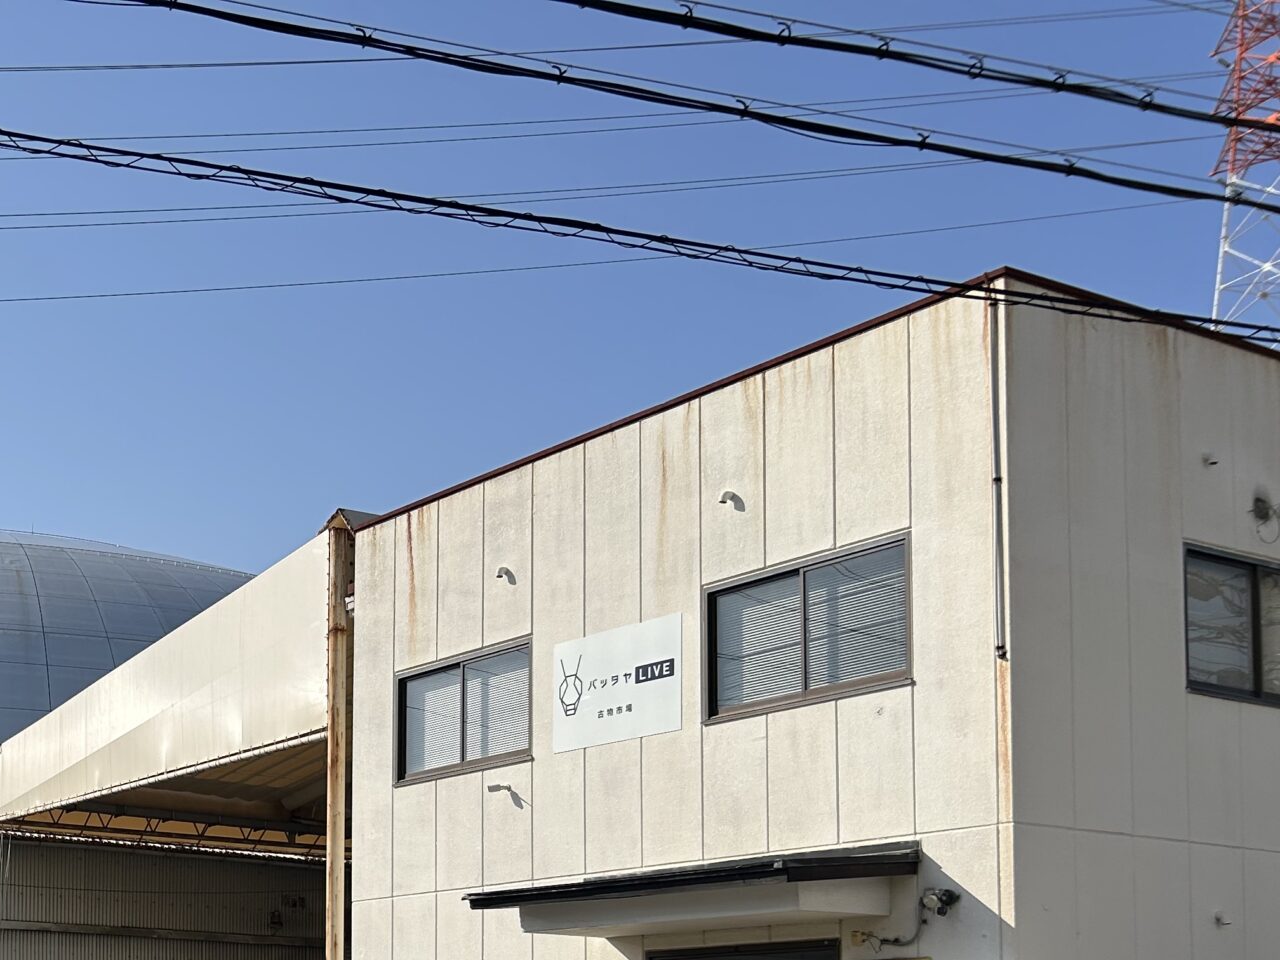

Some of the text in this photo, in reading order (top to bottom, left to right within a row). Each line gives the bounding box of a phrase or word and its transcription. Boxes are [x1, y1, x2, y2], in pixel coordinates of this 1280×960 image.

[587, 662, 670, 691] バッタヤ LIVE
[597, 703, 633, 719] 古物市場
